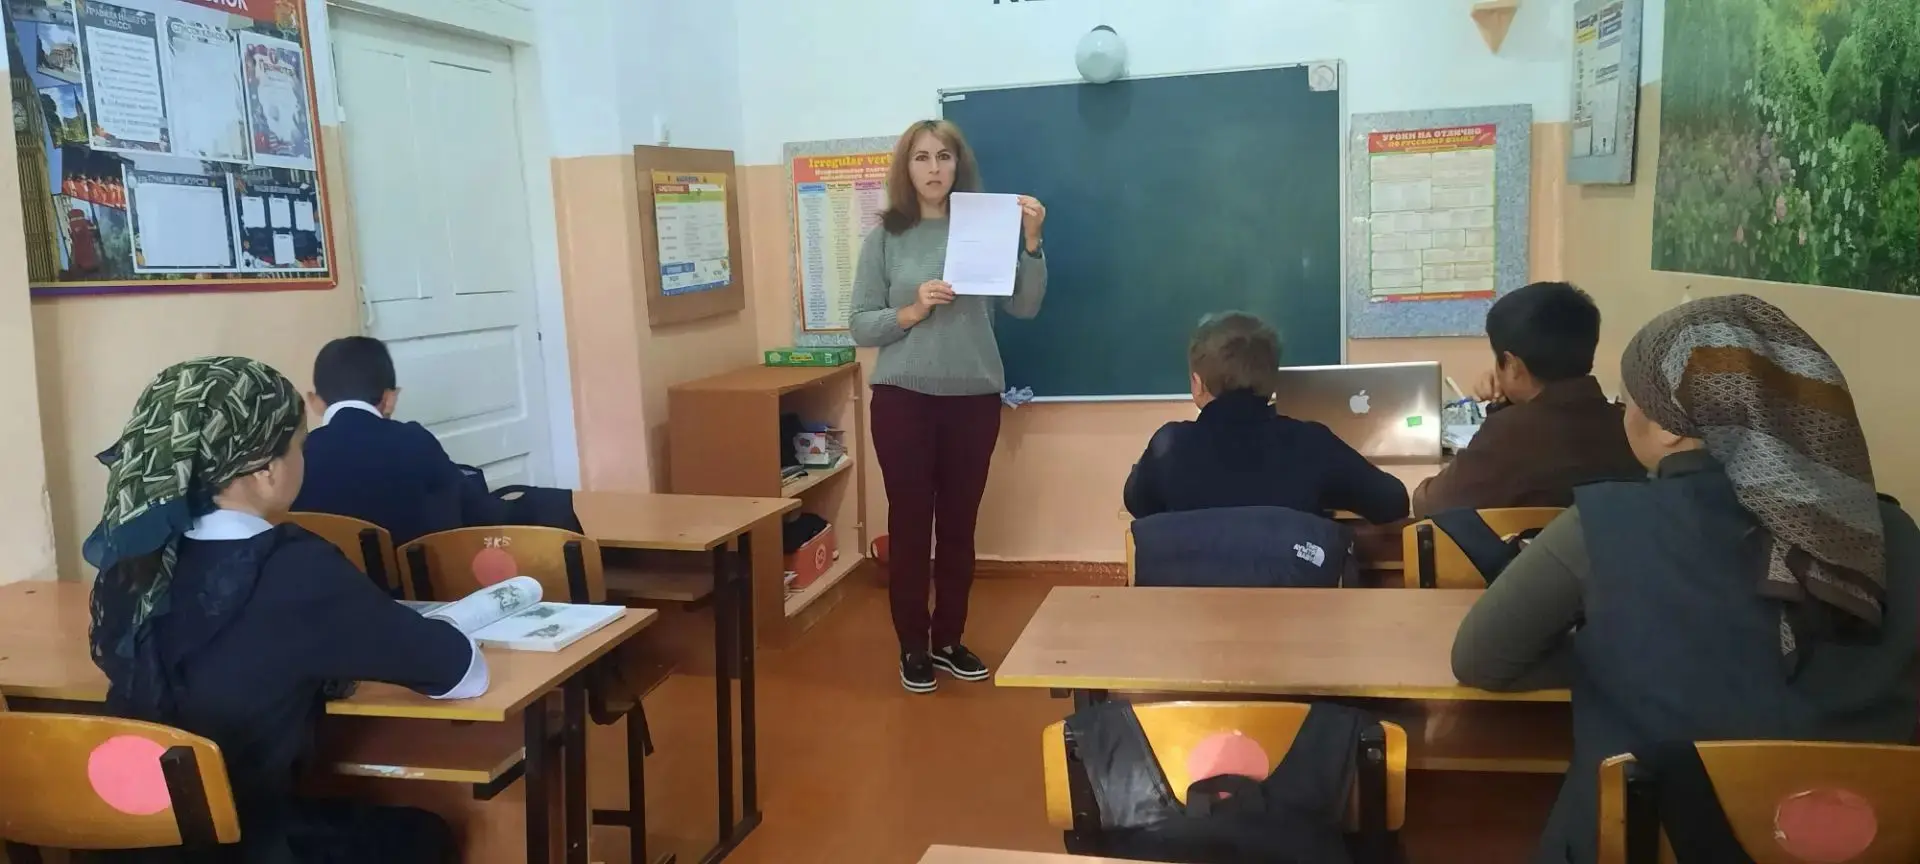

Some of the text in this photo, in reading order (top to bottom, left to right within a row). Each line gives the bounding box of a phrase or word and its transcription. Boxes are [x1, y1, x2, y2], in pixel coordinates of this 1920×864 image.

[1382, 127, 1482, 141] УРОКИ НА ОТЛИЧНО
[808, 156, 864, 168] Irregular
